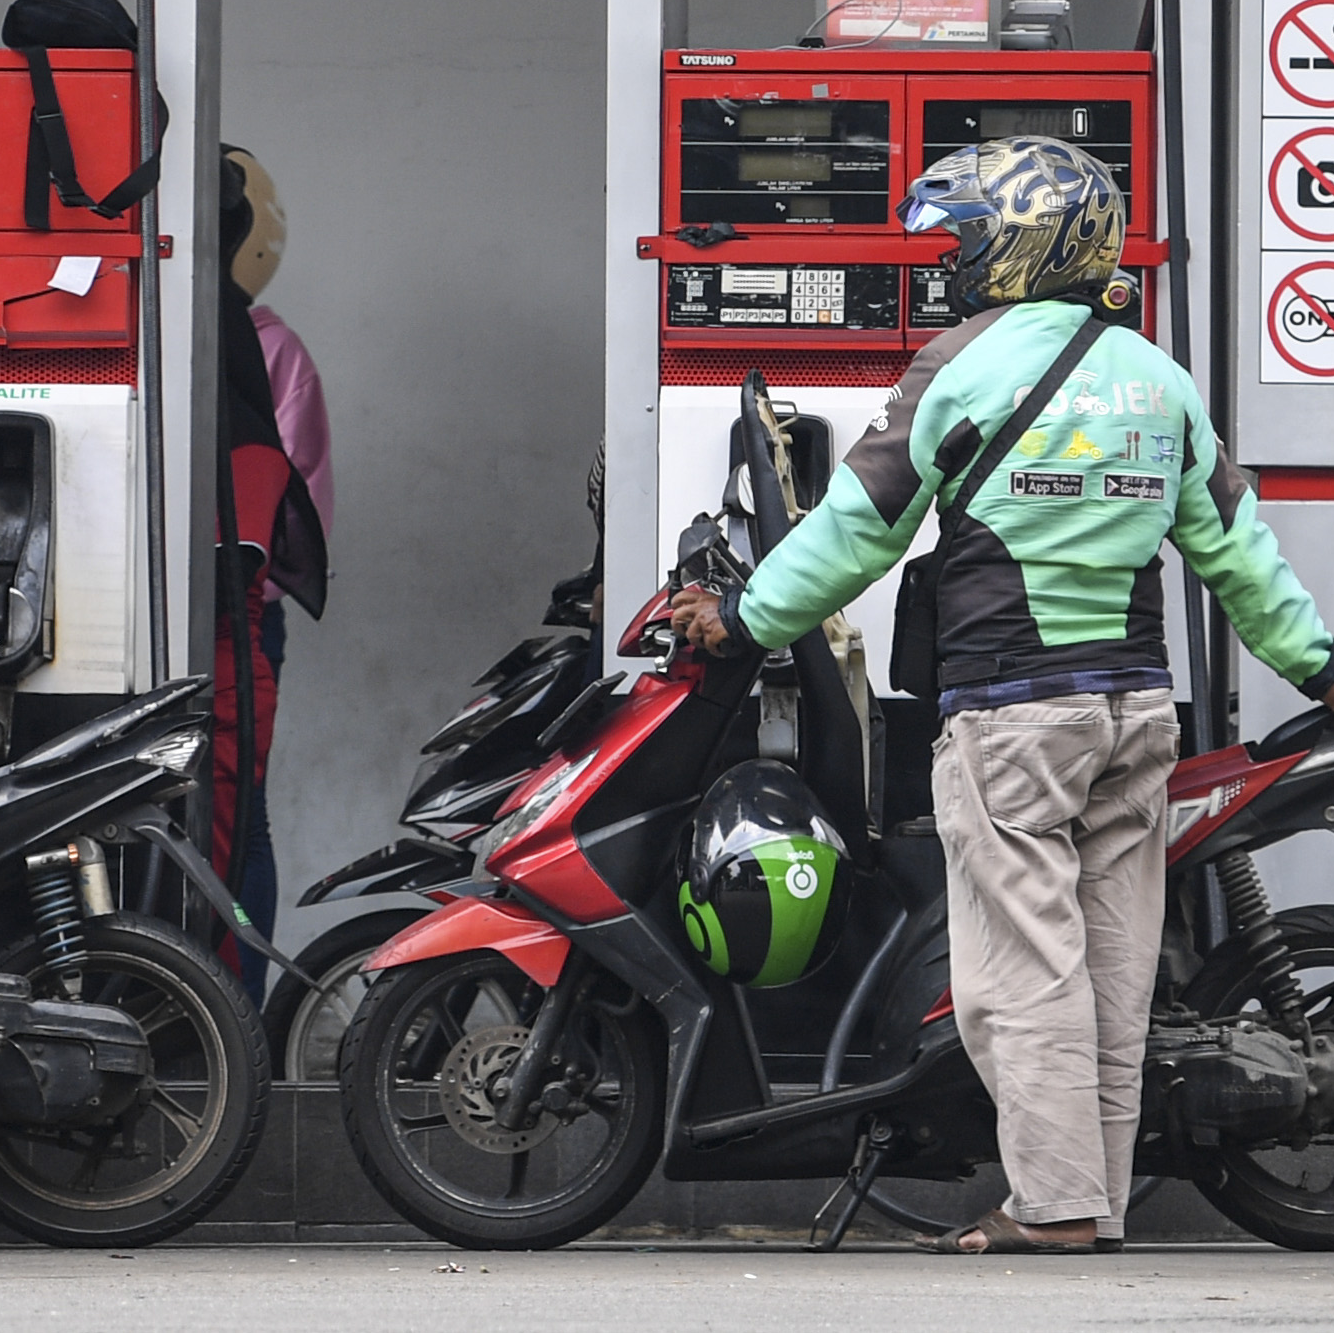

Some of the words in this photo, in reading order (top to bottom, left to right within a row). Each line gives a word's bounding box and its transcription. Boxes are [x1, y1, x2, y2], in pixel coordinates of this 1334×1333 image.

[681, 55, 734, 65] TATSUNO
[735, 311, 746, 319] P2
[748, 311, 759, 319] P3
[761, 311, 772, 320] P4
[1289, 310, 1323, 326] ON
[1111, 380, 1170, 417] JEK
[1028, 482, 1050, 495] App
[1053, 483, 1080, 494] Store
[1121, 485, 1149, 498] Google
